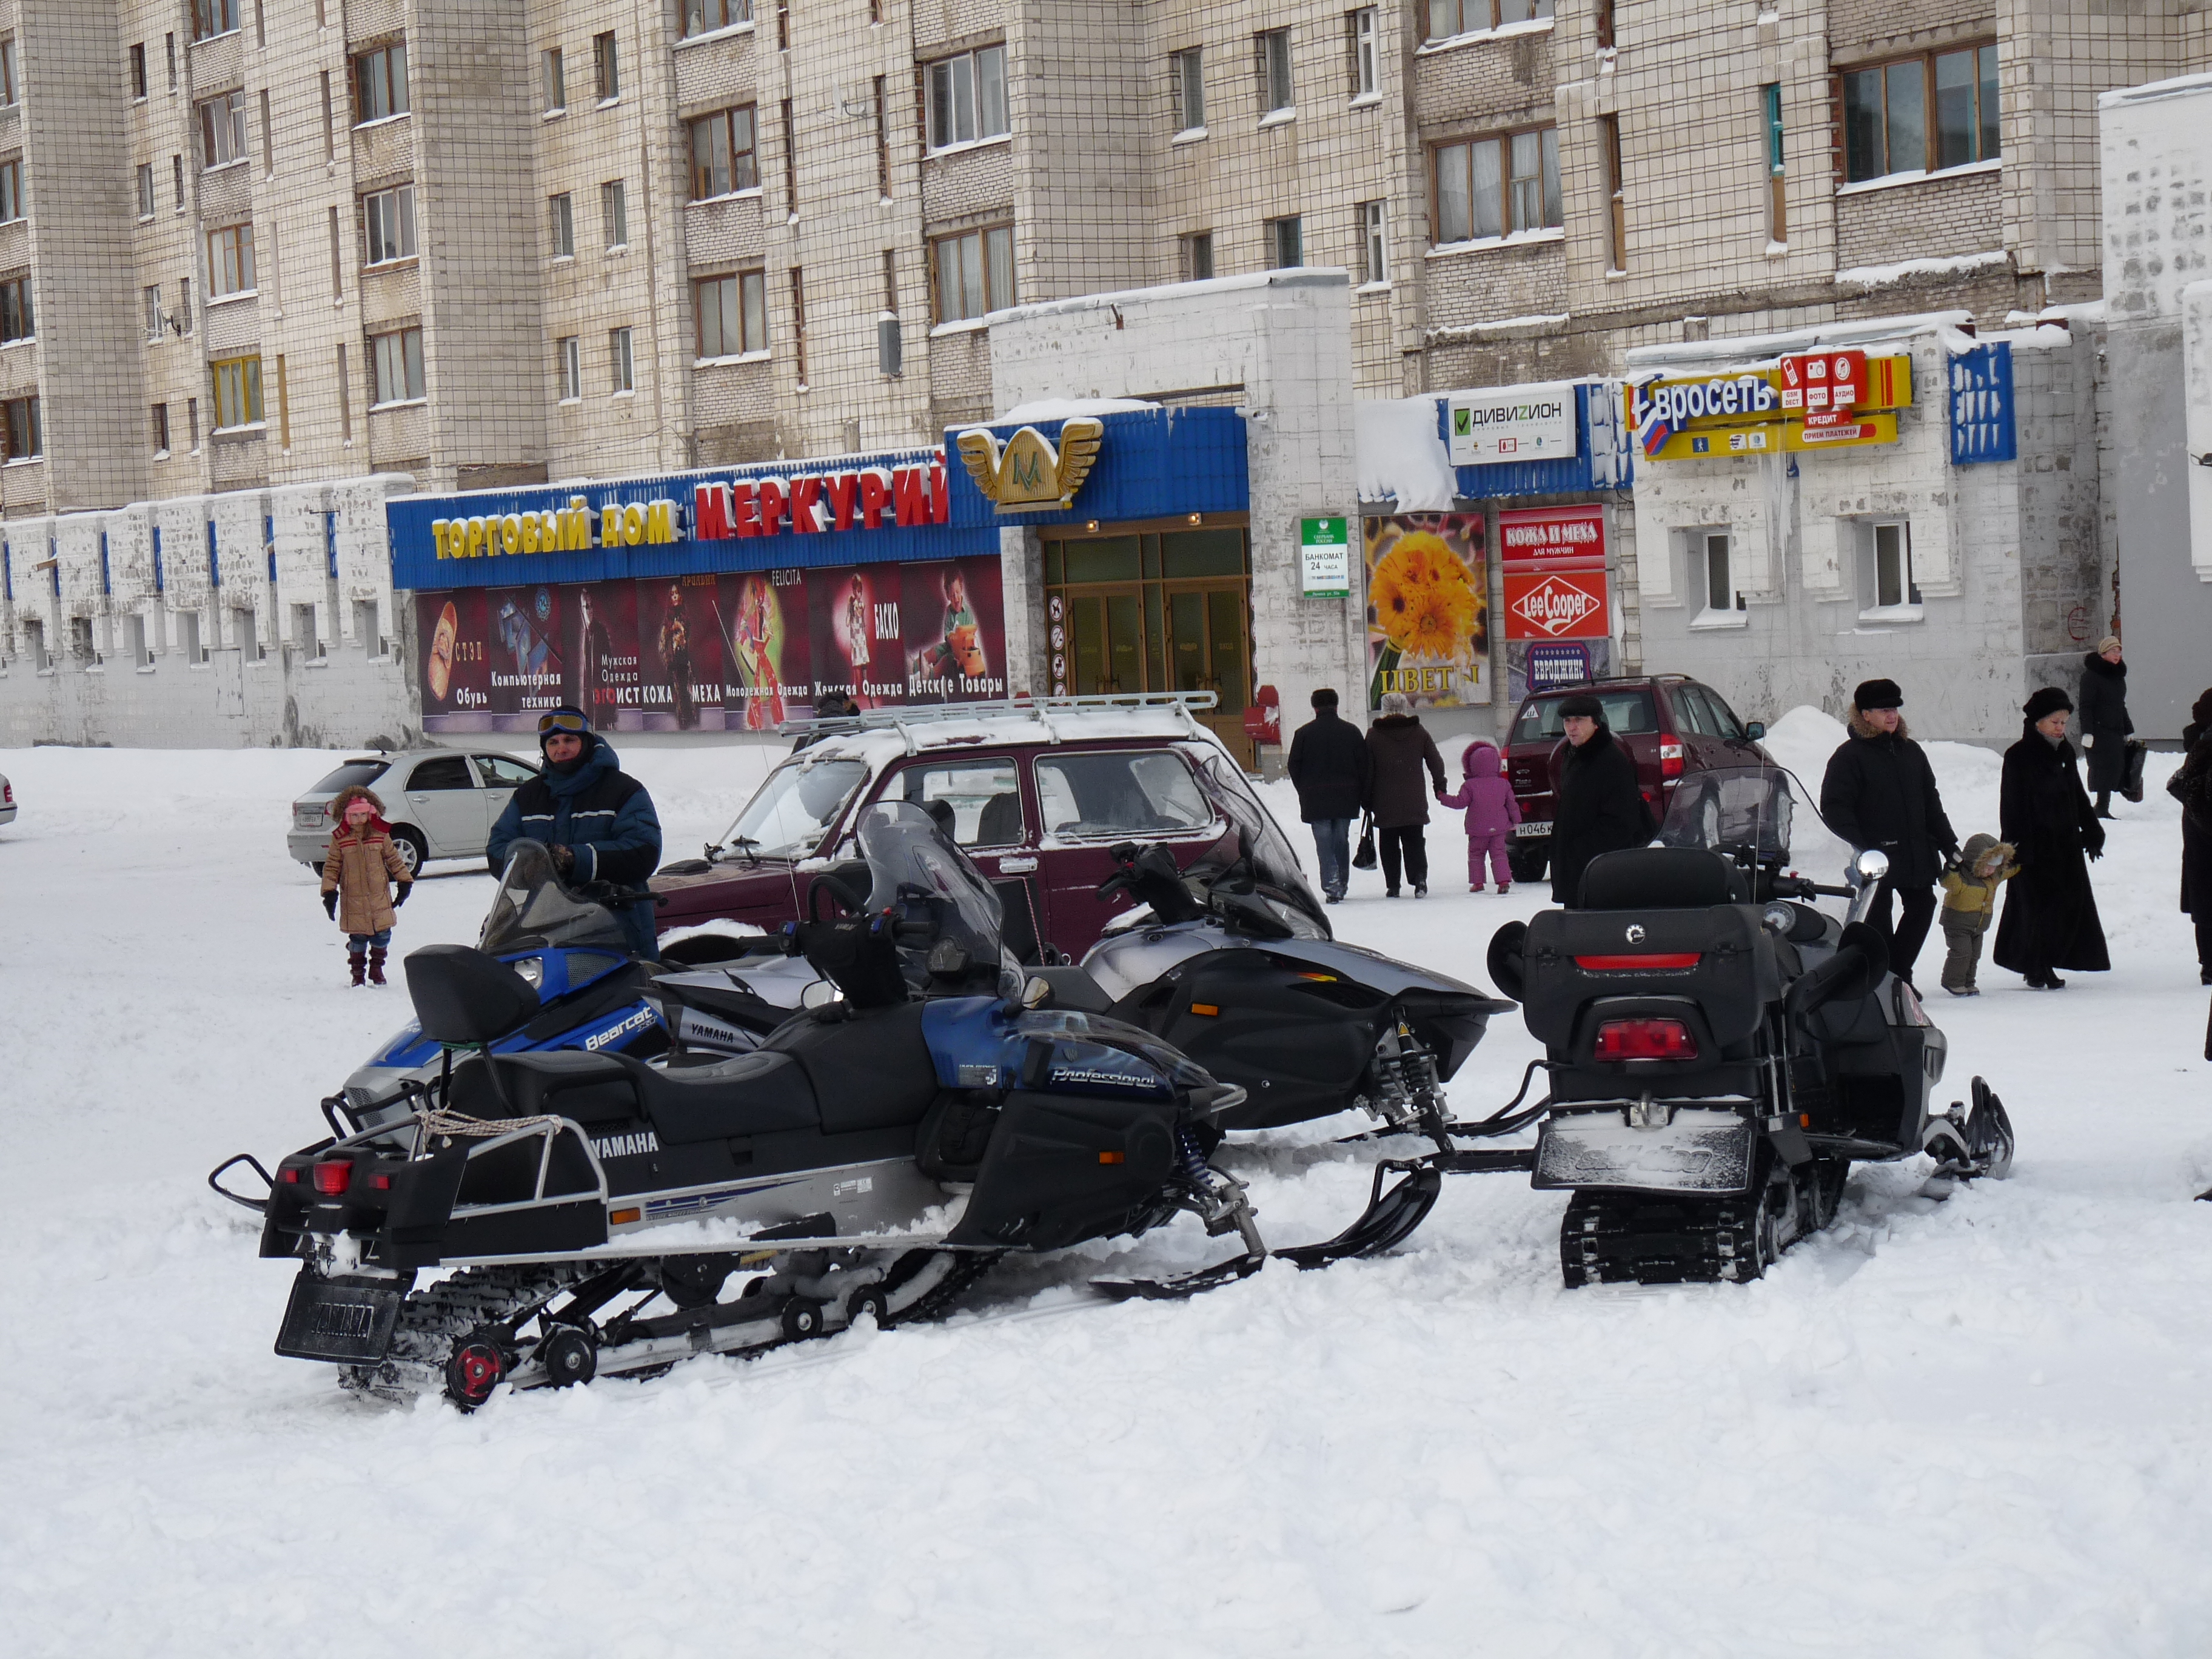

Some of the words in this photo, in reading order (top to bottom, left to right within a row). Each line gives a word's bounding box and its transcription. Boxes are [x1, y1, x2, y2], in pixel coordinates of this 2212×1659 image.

[1808, 414, 1837, 425] КРЕДИТ
[1804, 431, 1825, 440] ПРИЕМ
[1825, 427, 1857, 438] ПЛАТЕЖЕЙ
[432, 495, 589, 559] ТОРГОВЫЙ
[602, 502, 674, 548] ДОМ
[695, 451, 950, 540] МЕРКУРИЙ
[1506, 525, 1548, 548] КОЖА
[1548, 525, 1560, 544] И
[1561, 522, 1598, 545] МЕХА
[1305, 552, 1344, 561] БАНКОМАТ
[1546, 546, 1574, 555] МУЖЧИН
[1311, 561, 1321, 570] 24
[772, 569, 802, 586] FELICITA
[874, 602, 899, 640] БАСКО
[455, 641, 482, 662] СТЭП
[602, 654, 637, 669] Мужская
[1534, 659, 1584, 683] ЕВРОДЖИНС
[491, 671, 561, 690] Компьютерная
[602, 669, 638, 683] Одежда
[959, 673, 1004, 698] Товары
[1380, 665, 1479, 694] ЦВЕТЫ
[457, 687, 488, 708] Обувь
[594, 686, 640, 705] ЭГОИСТ
[643, 685, 673, 703] КОЖА
[692, 684, 721, 702] МЕХА
[777, 682, 808, 697] Одежда
[862, 679, 902, 697] Одежда
[521, 695, 562, 709] техника
[585, 1005, 653, 1050] Bearcat
[691, 1024, 734, 1043] YAMAHA
[1051, 1067, 1158, 1089] Professional
[590, 1131, 659, 1159] YAMAHA
